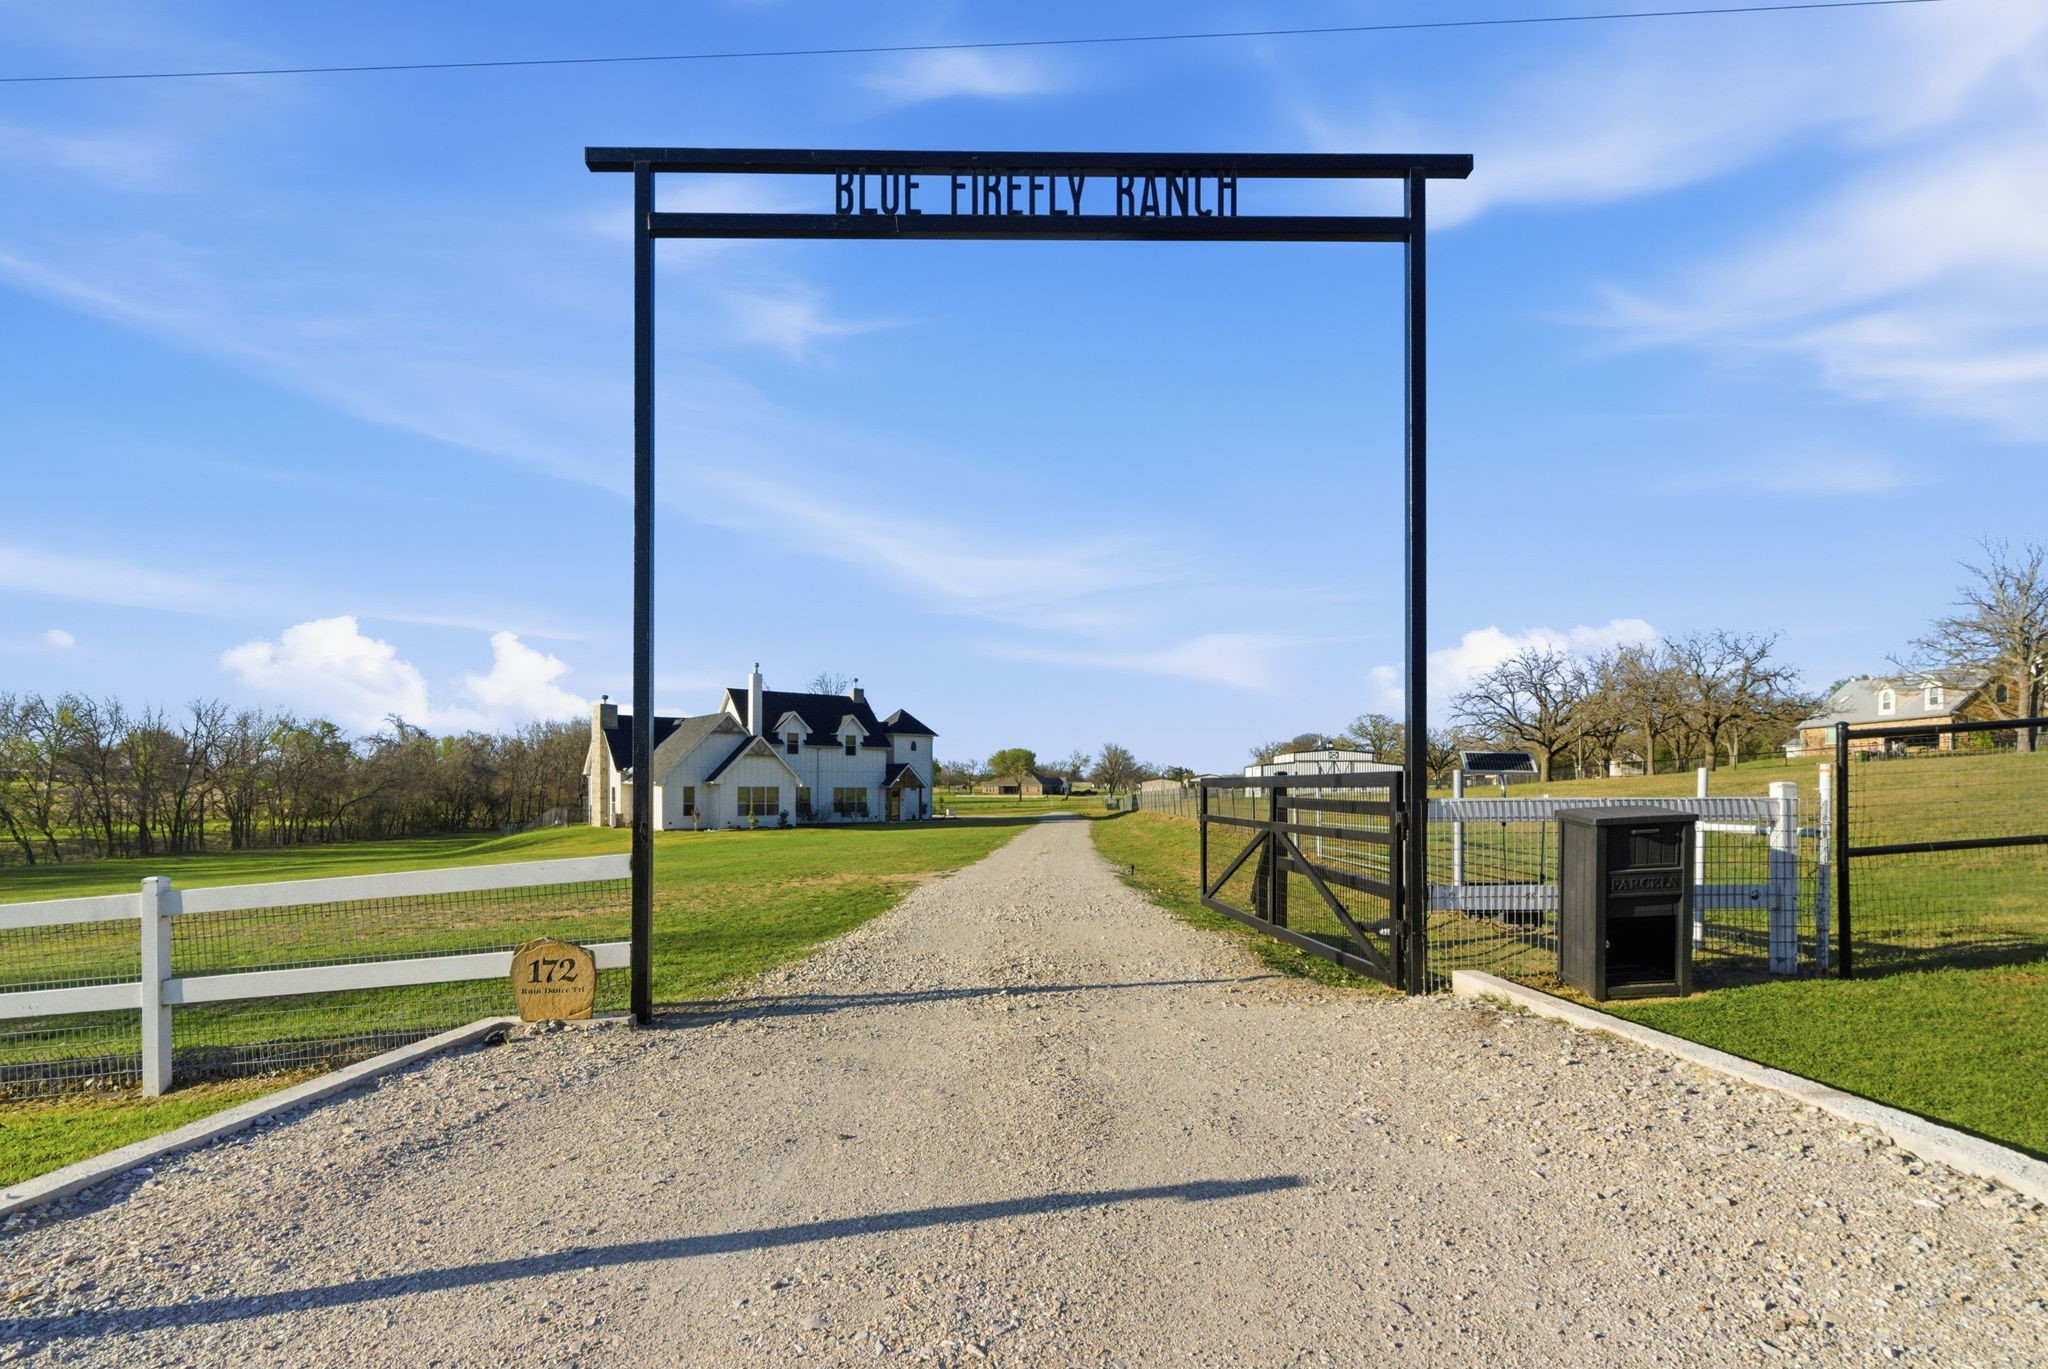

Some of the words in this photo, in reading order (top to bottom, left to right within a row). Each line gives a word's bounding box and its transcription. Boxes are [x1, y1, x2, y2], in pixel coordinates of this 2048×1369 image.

[835, 168, 922, 215] BLUE
[951, 168, 1087, 216] FIREFLY
[1116, 169, 1238, 217] RANCH
[1610, 876, 1678, 890] PARCELS
[528, 957, 578, 983] 172
